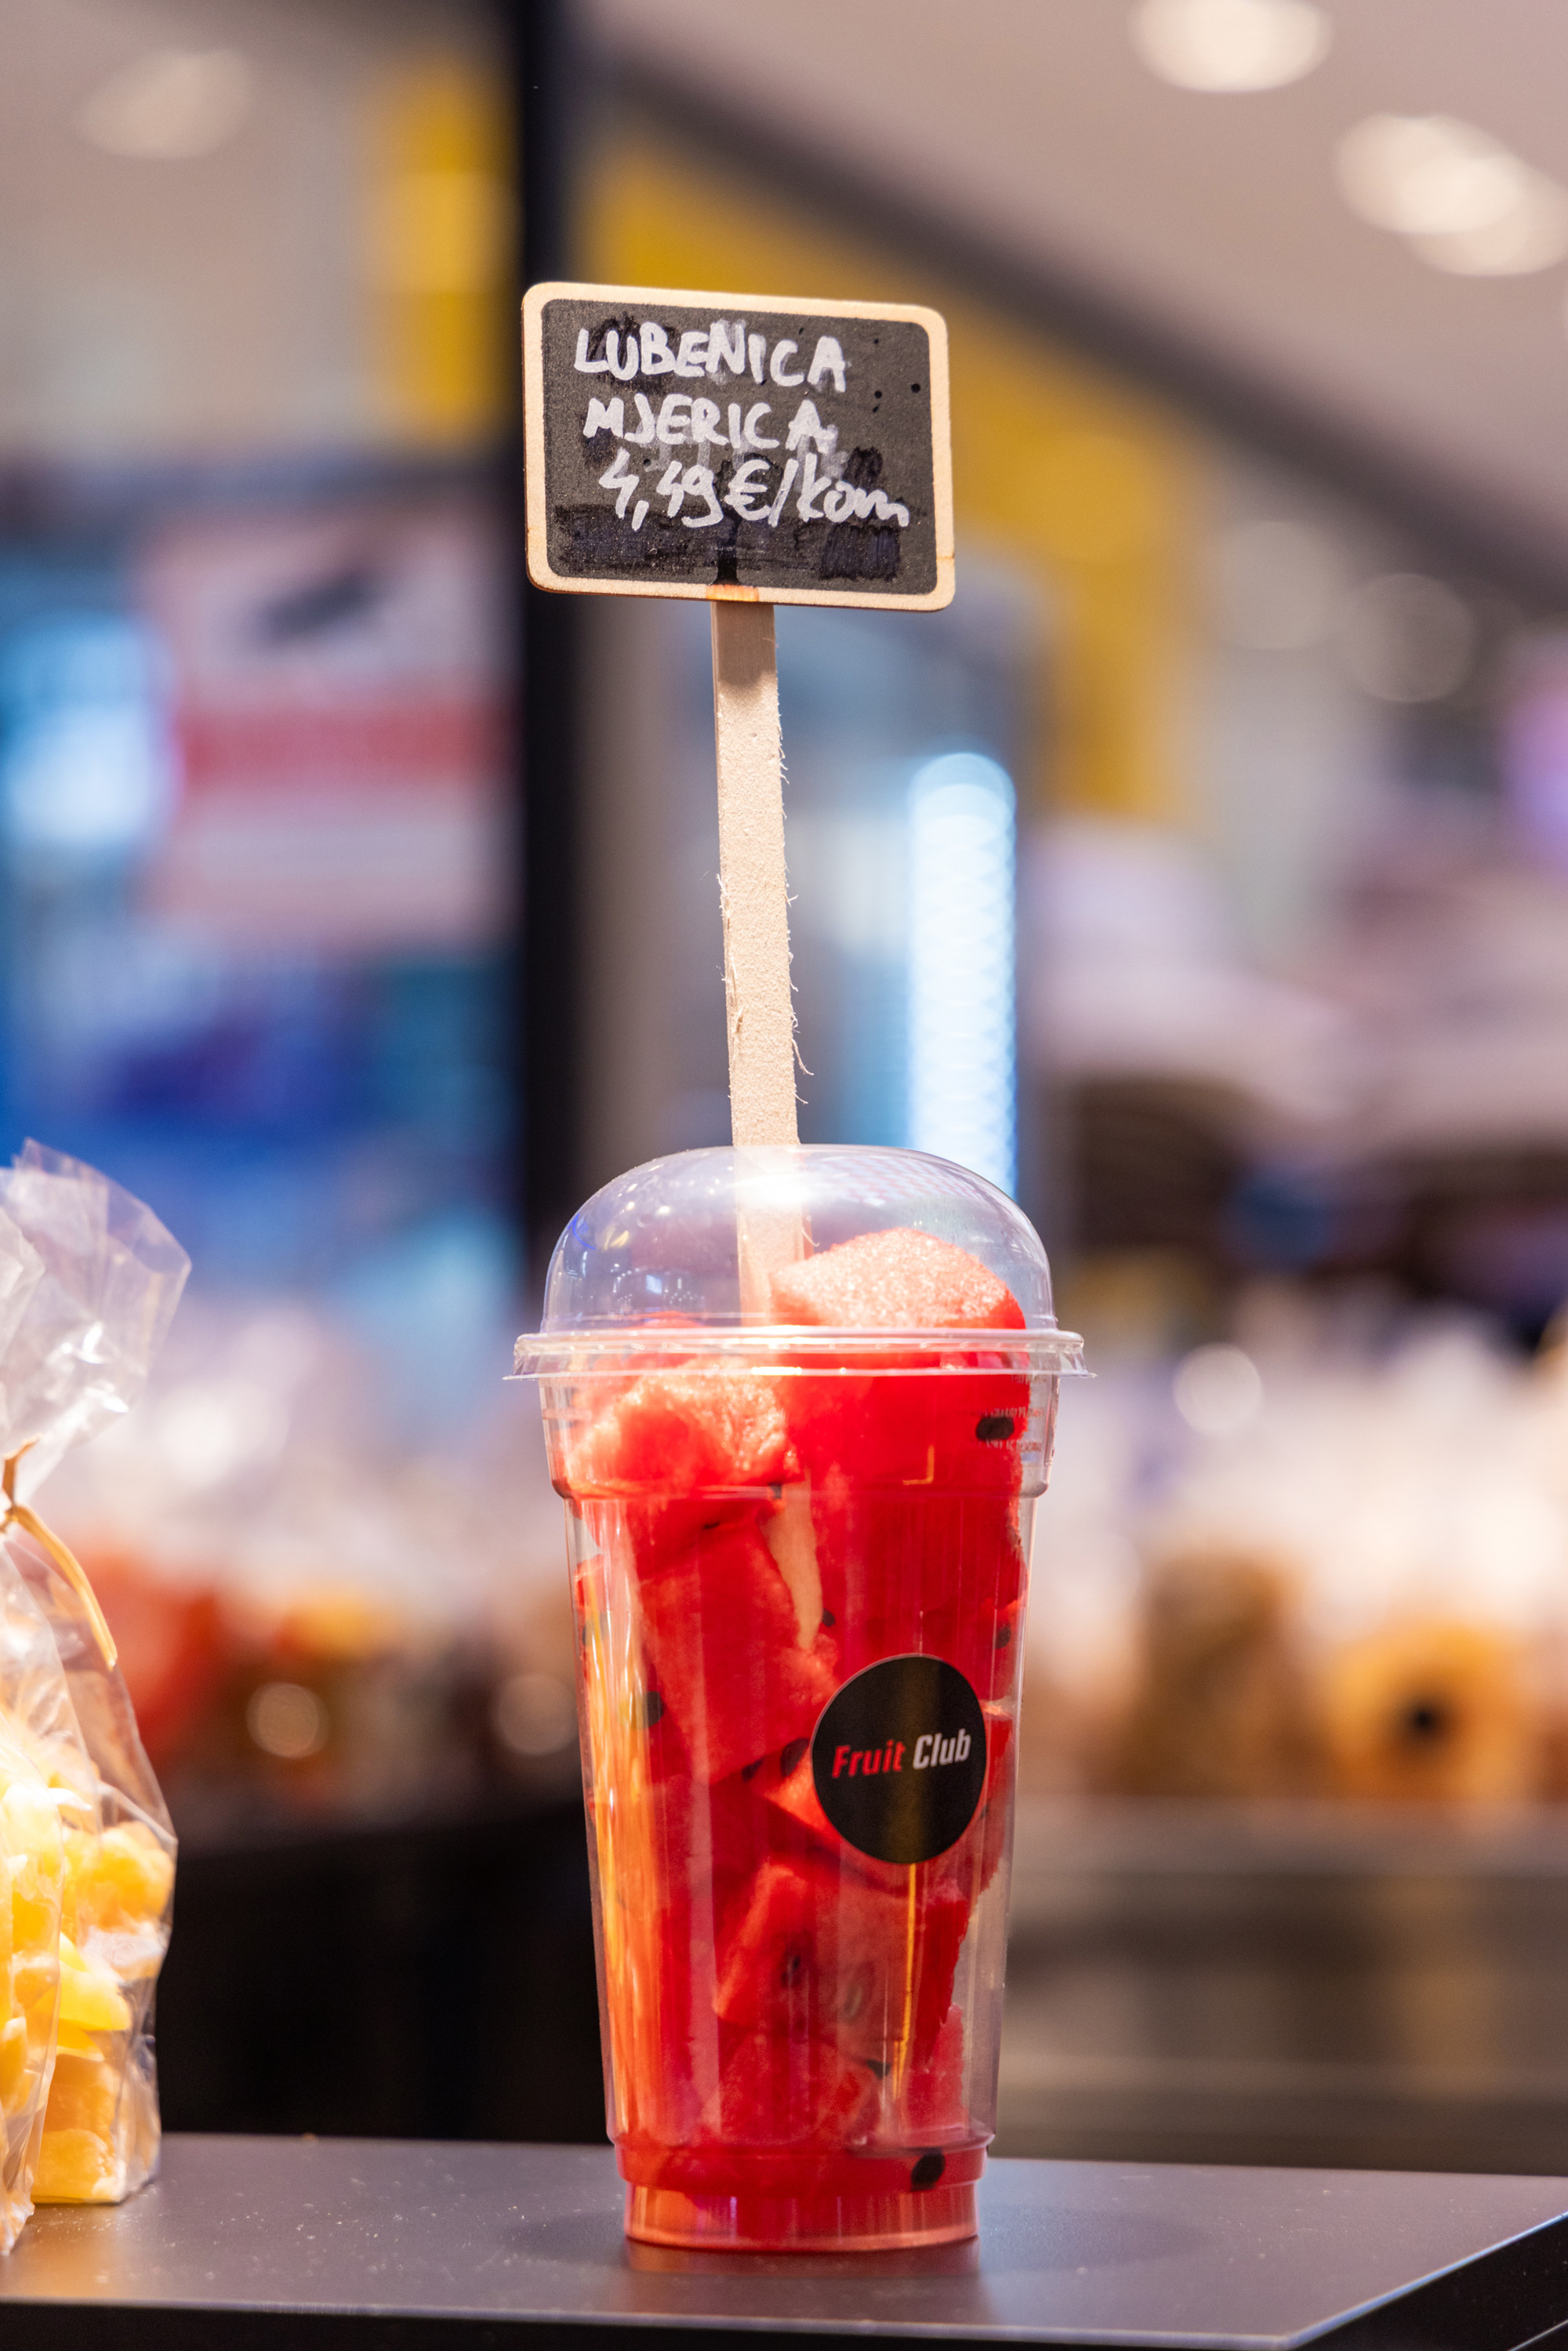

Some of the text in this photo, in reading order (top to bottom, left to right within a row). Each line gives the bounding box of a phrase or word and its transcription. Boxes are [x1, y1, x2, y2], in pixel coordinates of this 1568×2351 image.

[575, 318, 847, 393] LUBENICA
[583, 393, 837, 454] MJERICA
[832, 1728, 971, 1779] Fruit Club
